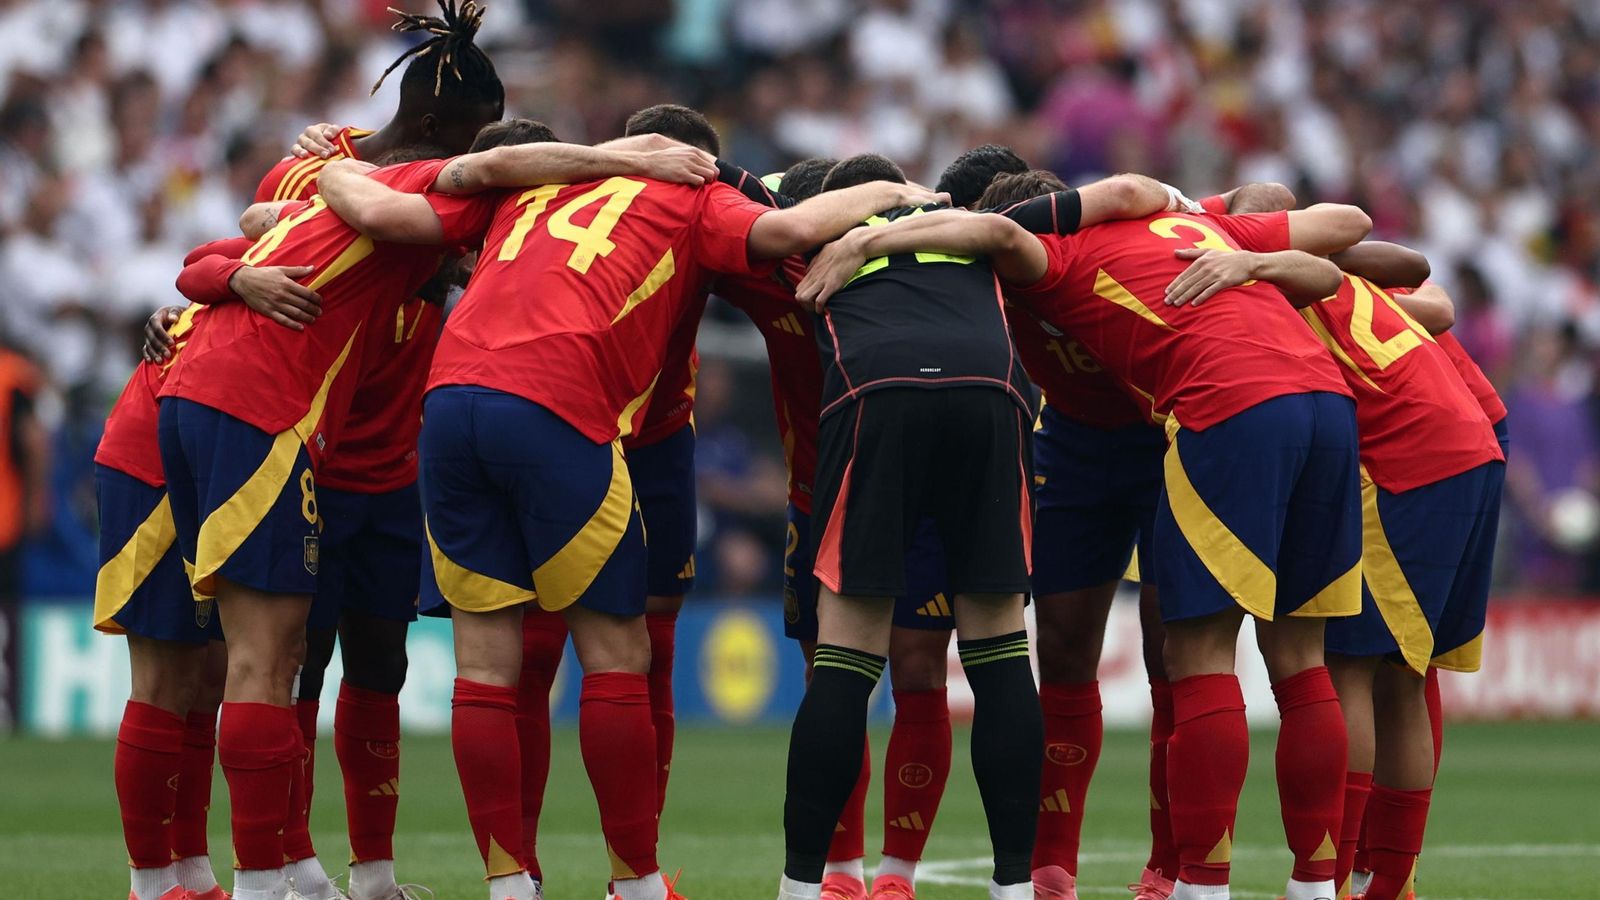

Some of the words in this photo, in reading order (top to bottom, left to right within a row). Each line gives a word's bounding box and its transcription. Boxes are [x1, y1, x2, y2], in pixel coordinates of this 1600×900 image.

[497, 176, 648, 275] 14
[1046, 339, 1103, 374] 16
[300, 467, 318, 525] 8
